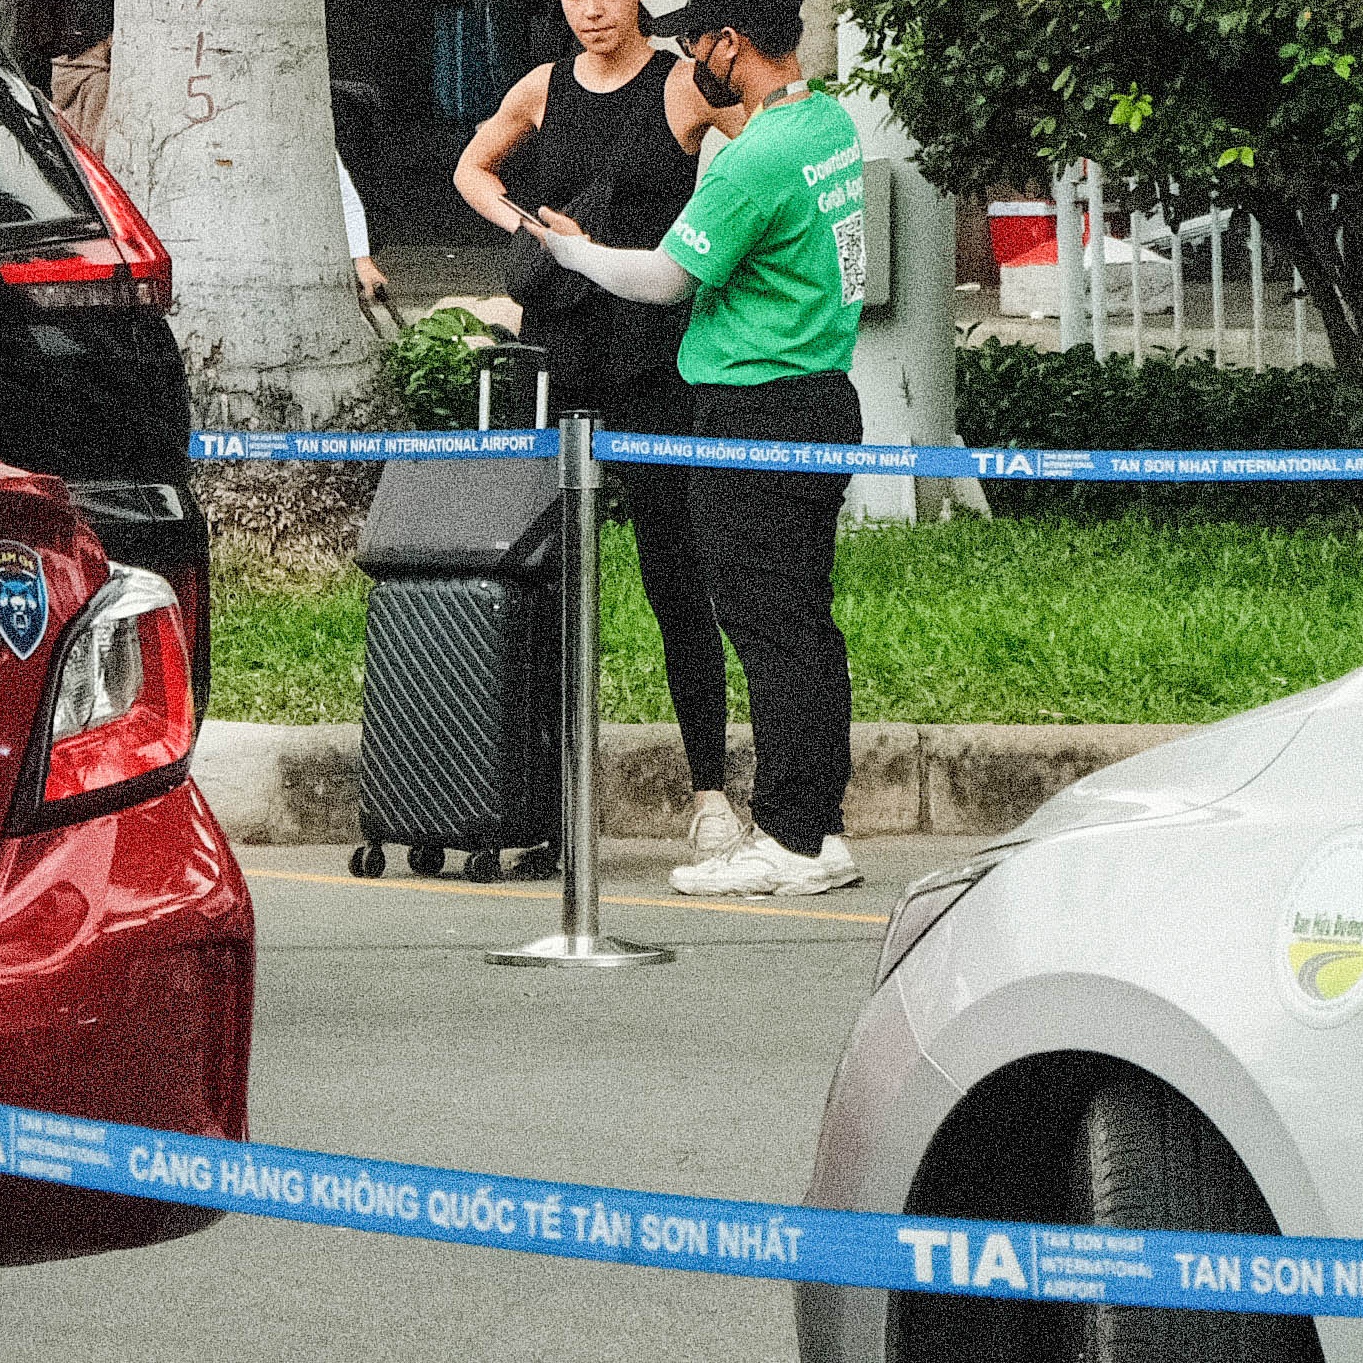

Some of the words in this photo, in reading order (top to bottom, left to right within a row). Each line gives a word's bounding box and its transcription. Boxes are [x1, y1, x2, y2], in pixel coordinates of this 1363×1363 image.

[673, 219, 712, 254] rab
[199, 435, 244, 457] TIA
[296, 439, 320, 453] TAN
[322, 439, 348, 453] SON
[350, 438, 381, 453] NHAT
[385, 436, 478, 453] INTERNATIONAL
[479, 435, 535, 452] AIRPORT
[696, 439, 746, 461] KHÔNG
[749, 442, 790, 464] QUỐC
[971, 452, 1034, 476] TIA
[1110, 458, 1140, 473] TAN
[1144, 459, 1176, 474] SON
[1178, 458, 1220, 474] NHAT
[1222, 457, 1337, 474] INTERNATIONAL
[129, 1141, 213, 1190] CẢNG
[220, 1153, 305, 1205] HÀNG
[311, 1169, 420, 1221] KHÔNG
[428, 1186, 515, 1234] QUỐC
[523, 1194, 563, 1241] TẾ
[572, 1200, 632, 1248] TÂN
[717, 1214, 803, 1263] NHẤT
[897, 1228, 1029, 1290] TIA
[1174, 1252, 1242, 1293] TAN
[1250, 1255, 1325, 1297] SON
